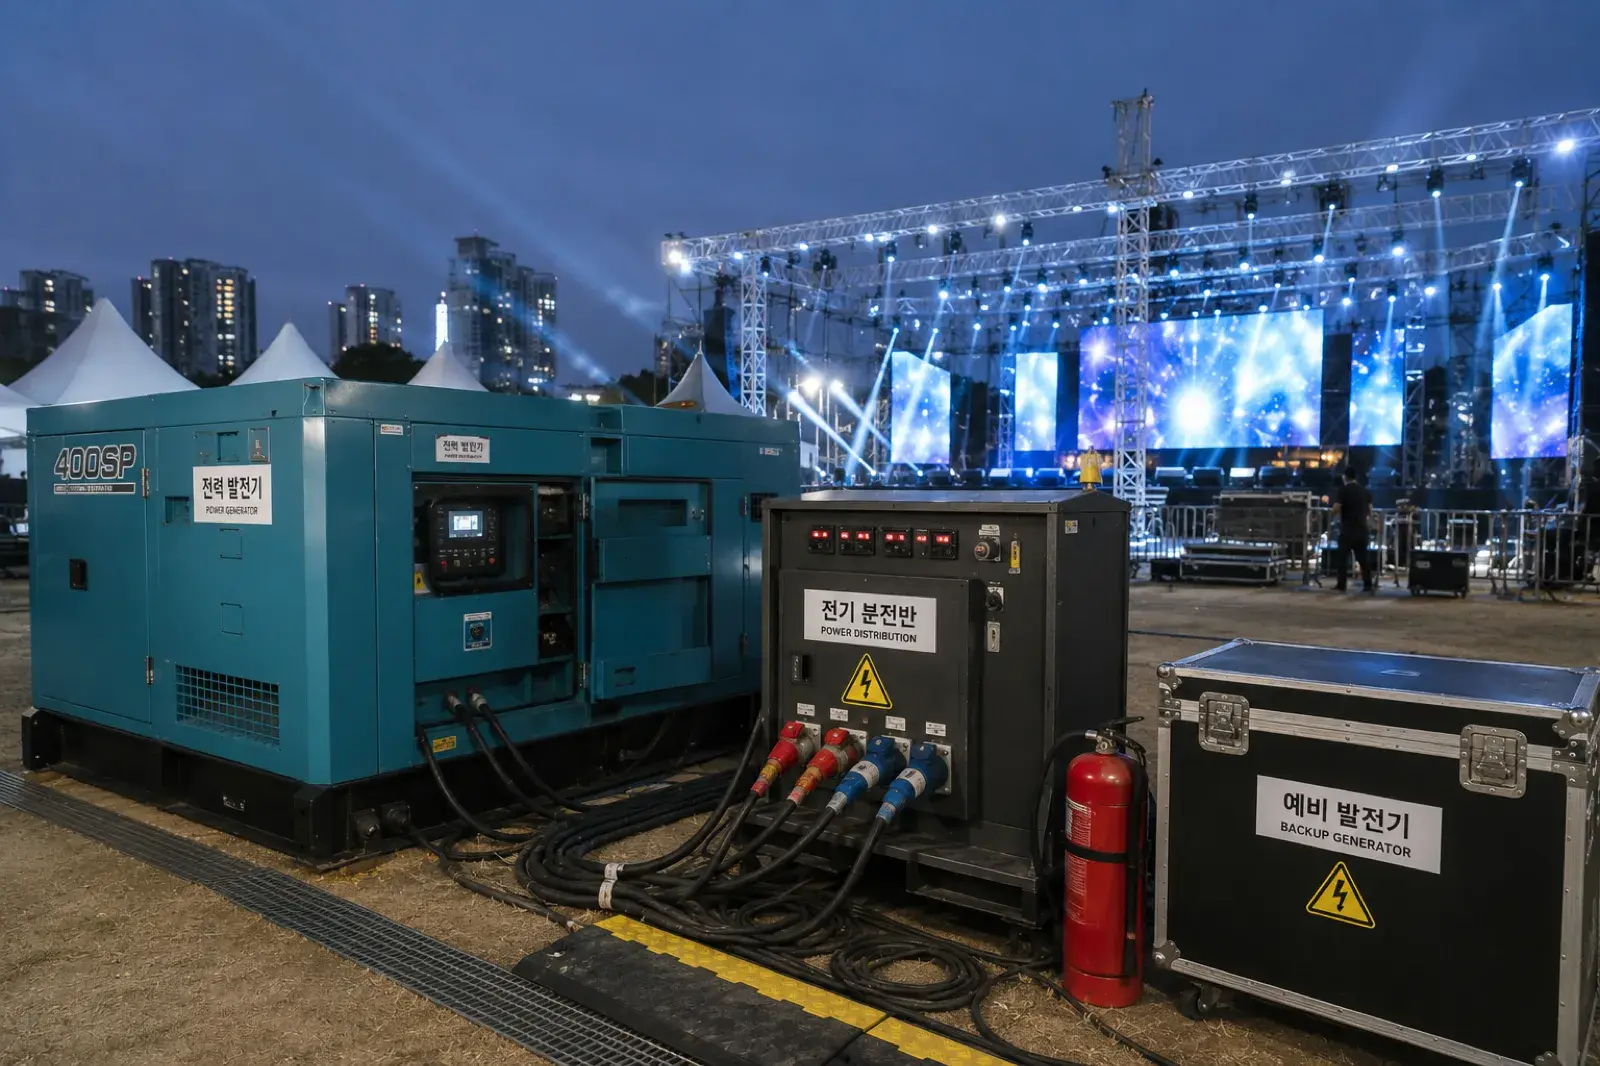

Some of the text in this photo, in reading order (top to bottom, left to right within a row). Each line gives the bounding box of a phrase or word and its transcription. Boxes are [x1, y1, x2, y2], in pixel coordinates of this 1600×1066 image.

[53, 444, 137, 480] 400SP
[202, 476, 262, 500] 전력 발전기
[206, 506, 258, 515] POWER GENERATOR
[821, 599, 917, 628] 전기 분전반
[821, 626, 917, 643] POWER DISTRIBUTION
[1283, 791, 1410, 839] 예비 발전기
[1281, 821, 1411, 858] BACKUP GENERATOR
